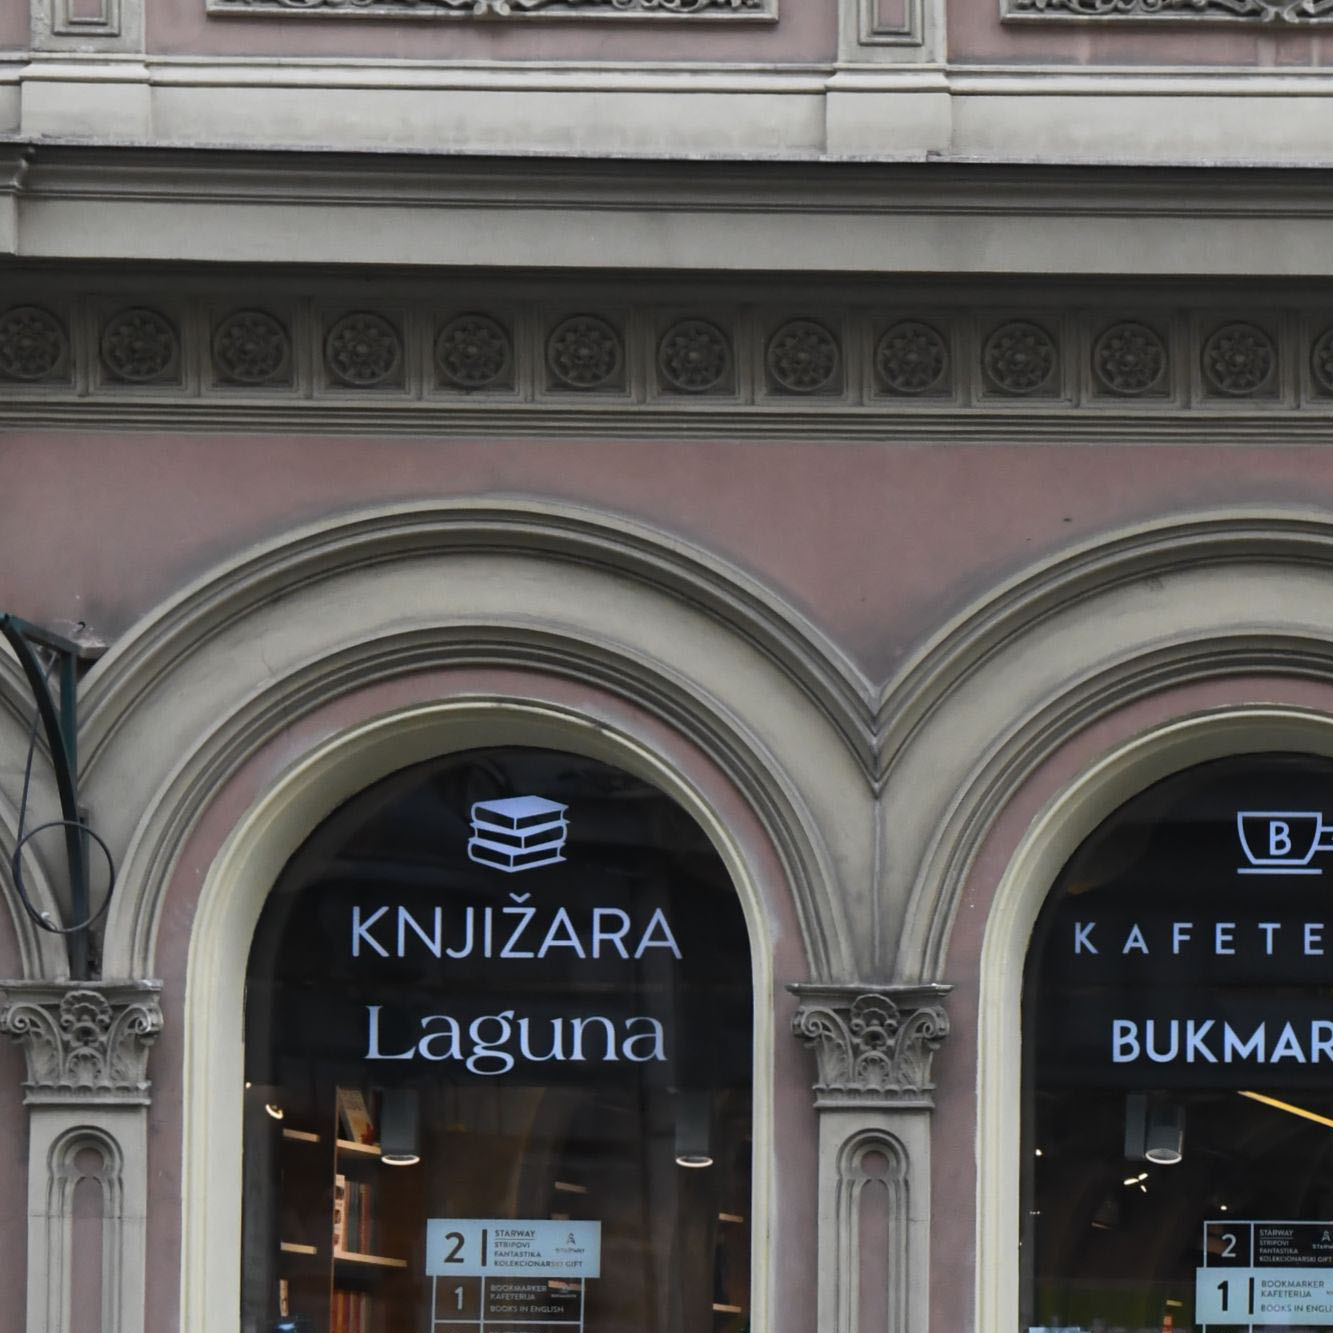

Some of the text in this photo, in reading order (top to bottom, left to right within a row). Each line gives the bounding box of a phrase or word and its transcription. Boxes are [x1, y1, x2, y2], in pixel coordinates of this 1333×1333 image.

[1269, 822, 1291, 855] B
[352, 893, 682, 959] KNJIŽARA
[365, 1005, 668, 1075] Laguna
[494, 1229, 535, 1237] STARWAY
[1260, 1229, 1294, 1237] STARWAY
[444, 1232, 465, 1263] 2
[1221, 1233, 1237, 1258] 2
[1217, 1280, 1229, 1311] 1
[1261, 1280, 1325, 1289] BOOKMARKER
[1261, 1291, 1312, 1299] KAFETERIJA
[454, 1286, 463, 1310] 1
[490, 1305, 518, 1313] BOOKS
[519, 1305, 529, 1313] IN
[1261, 1304, 1293, 1313] BOOKS
[1294, 1304, 1304, 1313] IN
